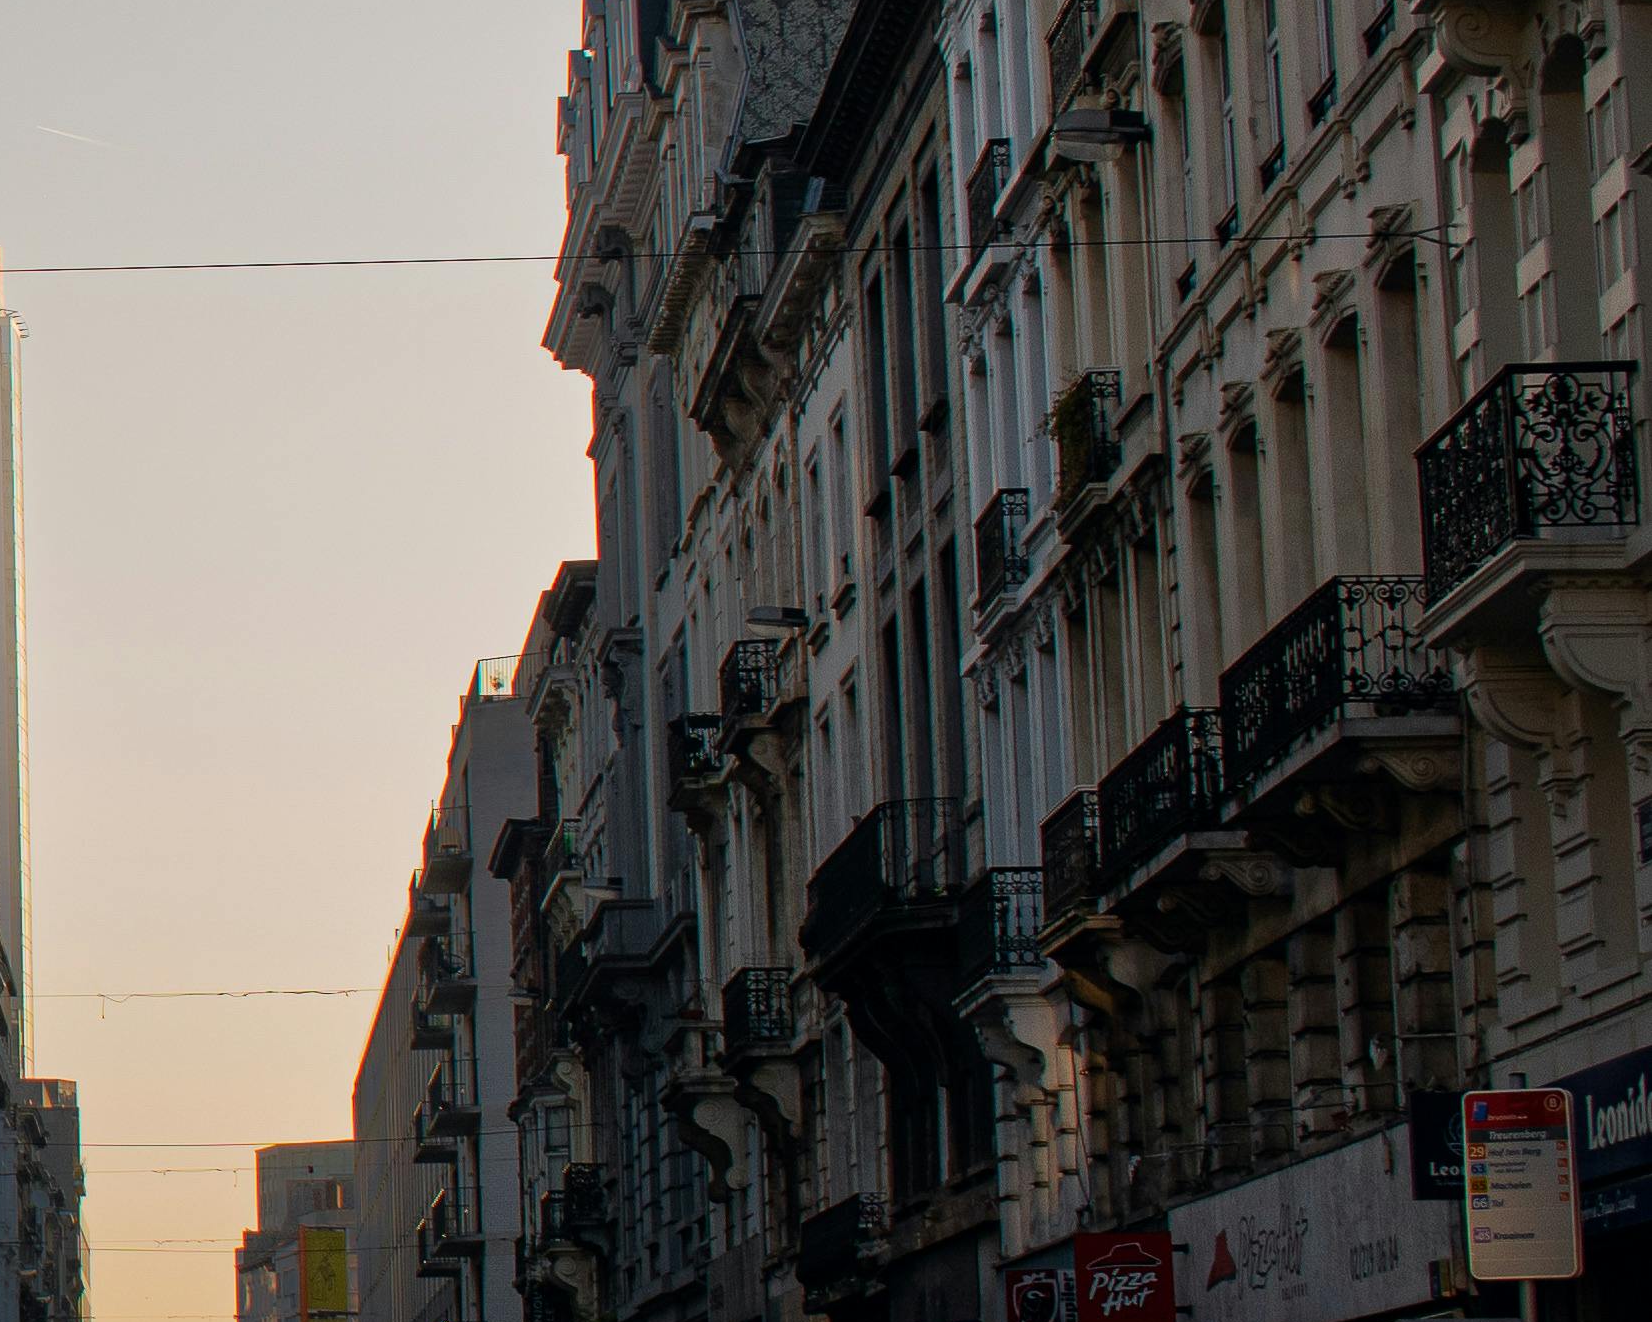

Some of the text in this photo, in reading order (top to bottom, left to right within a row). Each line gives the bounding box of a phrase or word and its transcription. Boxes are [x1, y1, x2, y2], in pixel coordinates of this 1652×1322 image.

[1470, 1146, 1485, 1158] 29
[1472, 1163, 1485, 1174] 63
[1472, 1180, 1485, 1191] 65
[1089, 1268, 1159, 1301] Pizza
[1101, 1287, 1156, 1317] Hut
